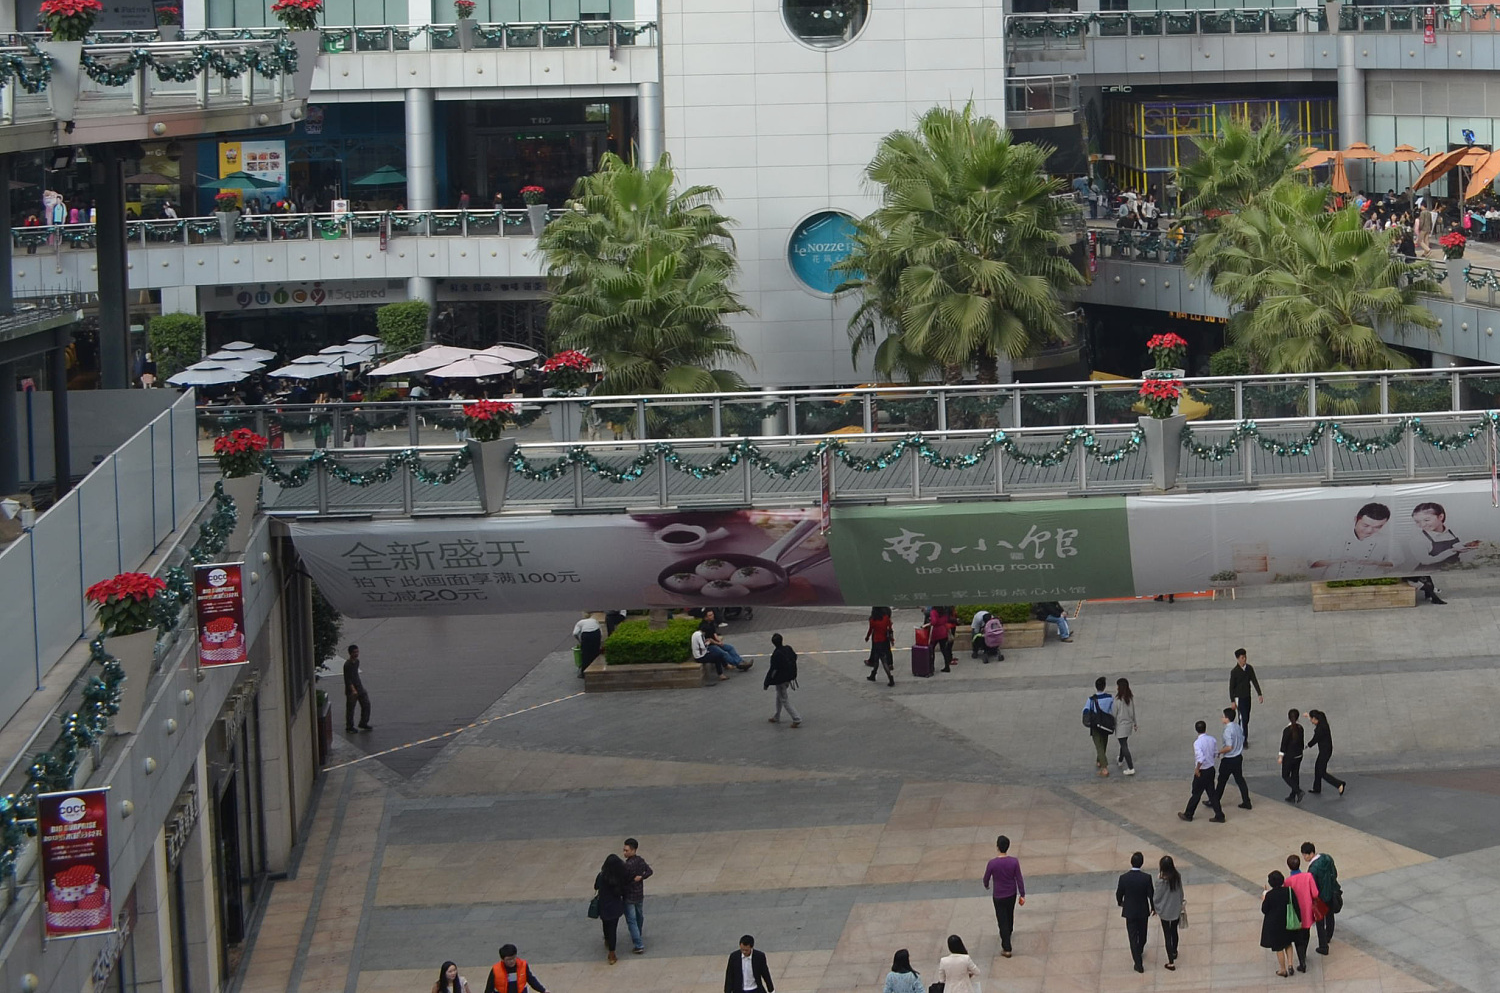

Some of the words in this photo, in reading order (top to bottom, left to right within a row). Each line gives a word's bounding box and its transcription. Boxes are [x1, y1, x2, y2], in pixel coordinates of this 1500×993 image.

[341, 539, 530, 572] 全新盛开
[915, 566, 943, 576] the
[947, 562, 1005, 575] dining
[1010, 561, 1056, 571] room
[352, 570, 581, 589] 拍下此画面享满100元
[361, 588, 488, 604] 立减20元
